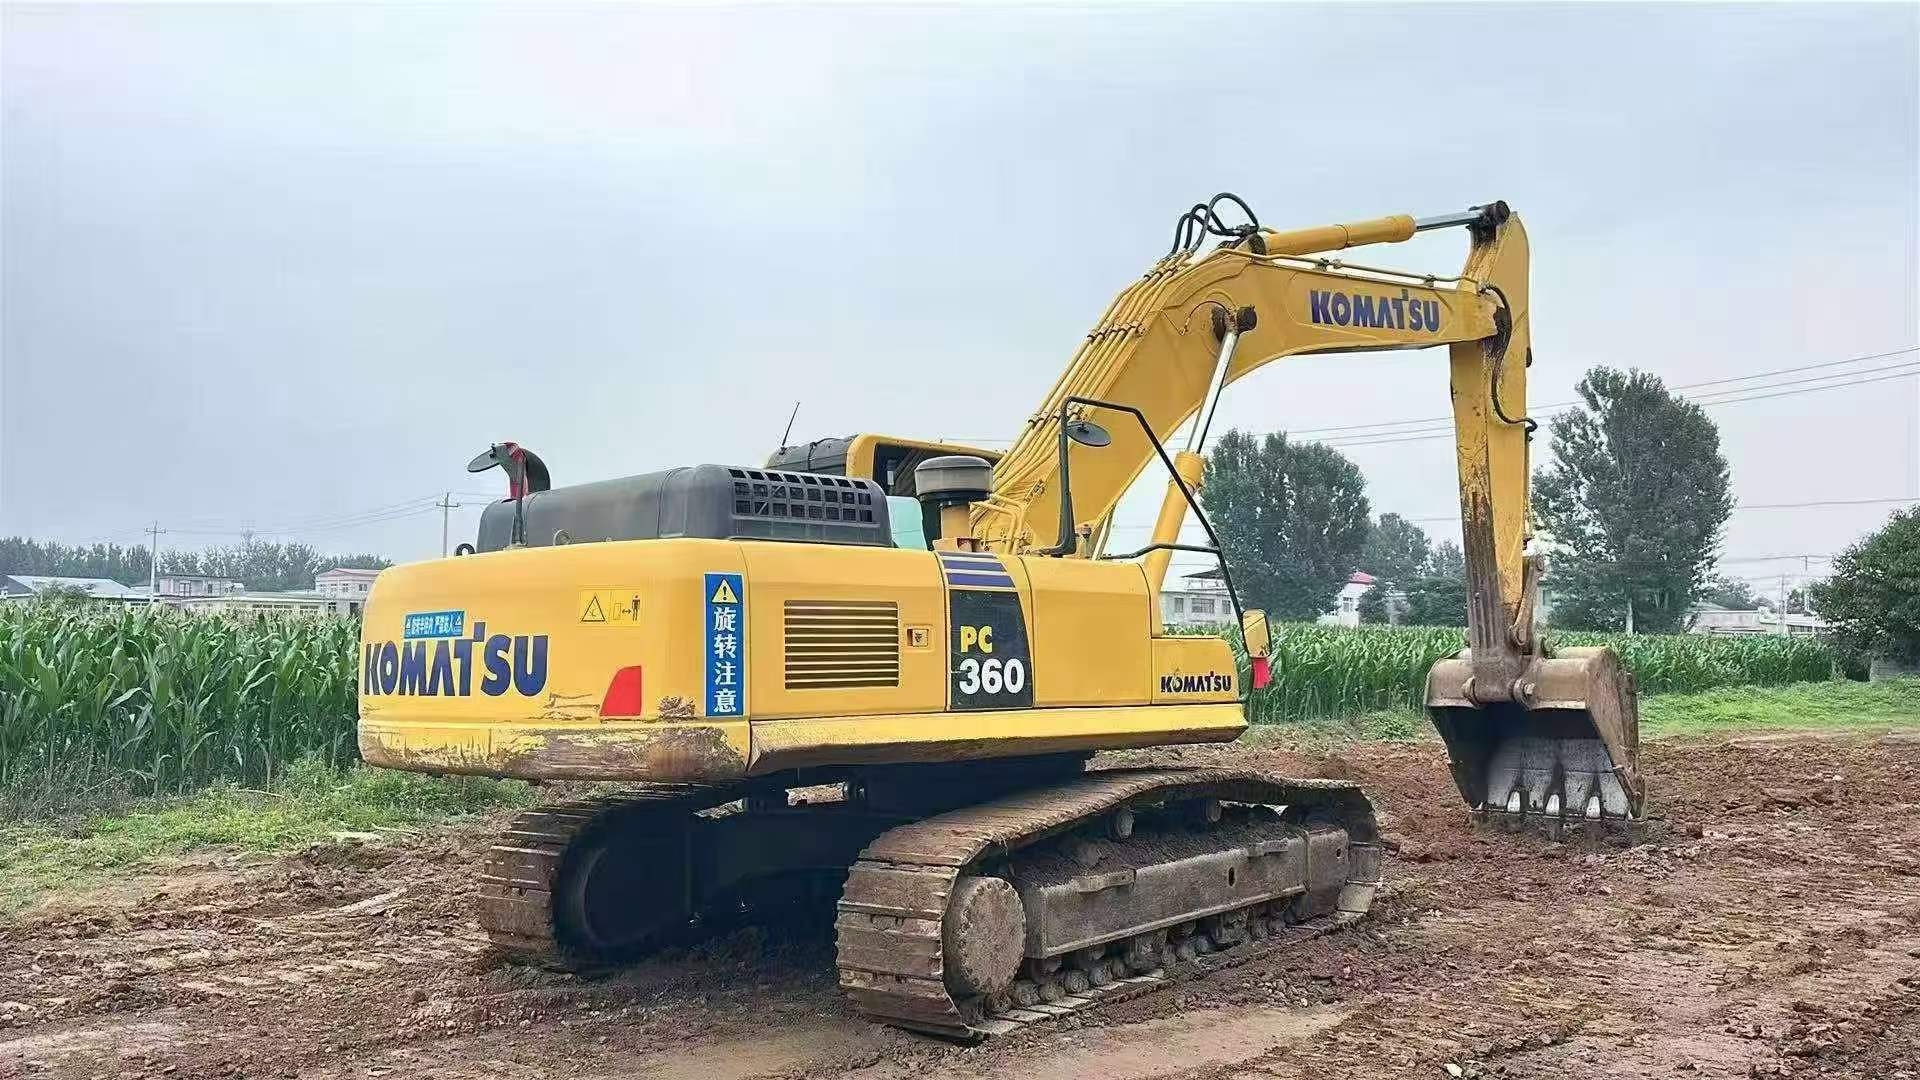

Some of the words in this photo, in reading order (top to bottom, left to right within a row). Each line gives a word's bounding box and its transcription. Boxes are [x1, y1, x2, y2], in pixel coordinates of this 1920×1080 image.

[1310, 288, 1440, 332] KOMATSU
[960, 625, 992, 653] PC
[364, 622, 549, 697] KOMATSU
[713, 606, 737, 713] 旋转注意
[960, 658, 1025, 694] 360
[1161, 671, 1232, 693] KOMATSU
